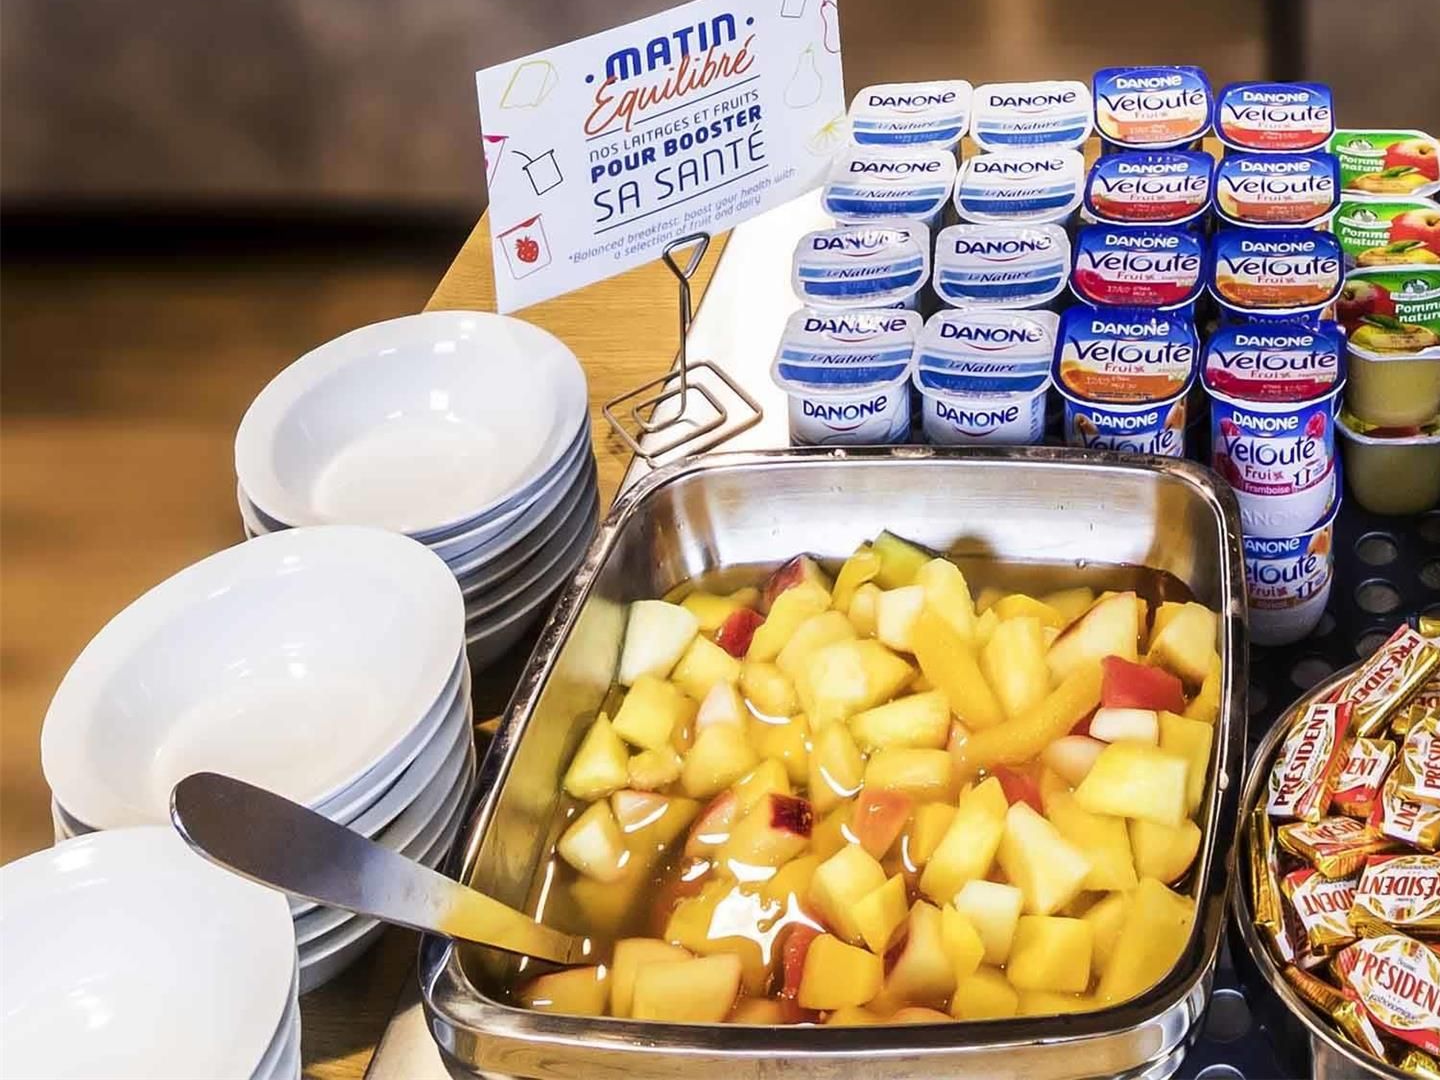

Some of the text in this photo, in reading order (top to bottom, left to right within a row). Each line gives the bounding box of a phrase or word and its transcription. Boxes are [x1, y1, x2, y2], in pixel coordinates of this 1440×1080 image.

[605, 12, 736, 84] MATIN
[1116, 74, 1183, 89] DANONE
[868, 91, 957, 108] DANONE
[989, 91, 1077, 108] DANONE
[1101, 88, 1204, 112] Velouté
[1224, 102, 1329, 122] Velouté
[589, 89, 760, 162] NOS LAITAGES ET FRUITS
[591, 104, 763, 184] POUR BOOSTER
[593, 123, 766, 223] SA SANTÉ
[850, 160, 942, 173] DANONE
[740, 178, 772, 198] health
[1098, 173, 1207, 193] Velouté
[1222, 173, 1332, 194] Velouté
[624, 231, 673, 257] selection
[675, 224, 686, 237] of
[689, 214, 712, 232] fruit
[1105, 234, 1179, 248] DANONE
[1341, 226, 1391, 239] Pomme
[1343, 236, 1389, 247] nature
[1241, 240, 1316, 253] DANONE
[1084, 248, 1199, 272] Velouté
[1220, 253, 1339, 276] Velouté
[1091, 320, 1170, 336] DANONE
[1068, 335, 1192, 364] Velouté
[1235, 335, 1314, 347] DANONE
[1213, 346, 1337, 370] Velouté
[802, 395, 888, 418] DANONE
[936, 401, 1020, 426] DANONE
[1091, 412, 1159, 429] DANONE
[1232, 411, 1299, 430] DANONE
[1223, 432, 1317, 466] Velouté
[1244, 483, 1291, 495] Framboise
[1273, 708, 1330, 807] PRÉSIDENT
